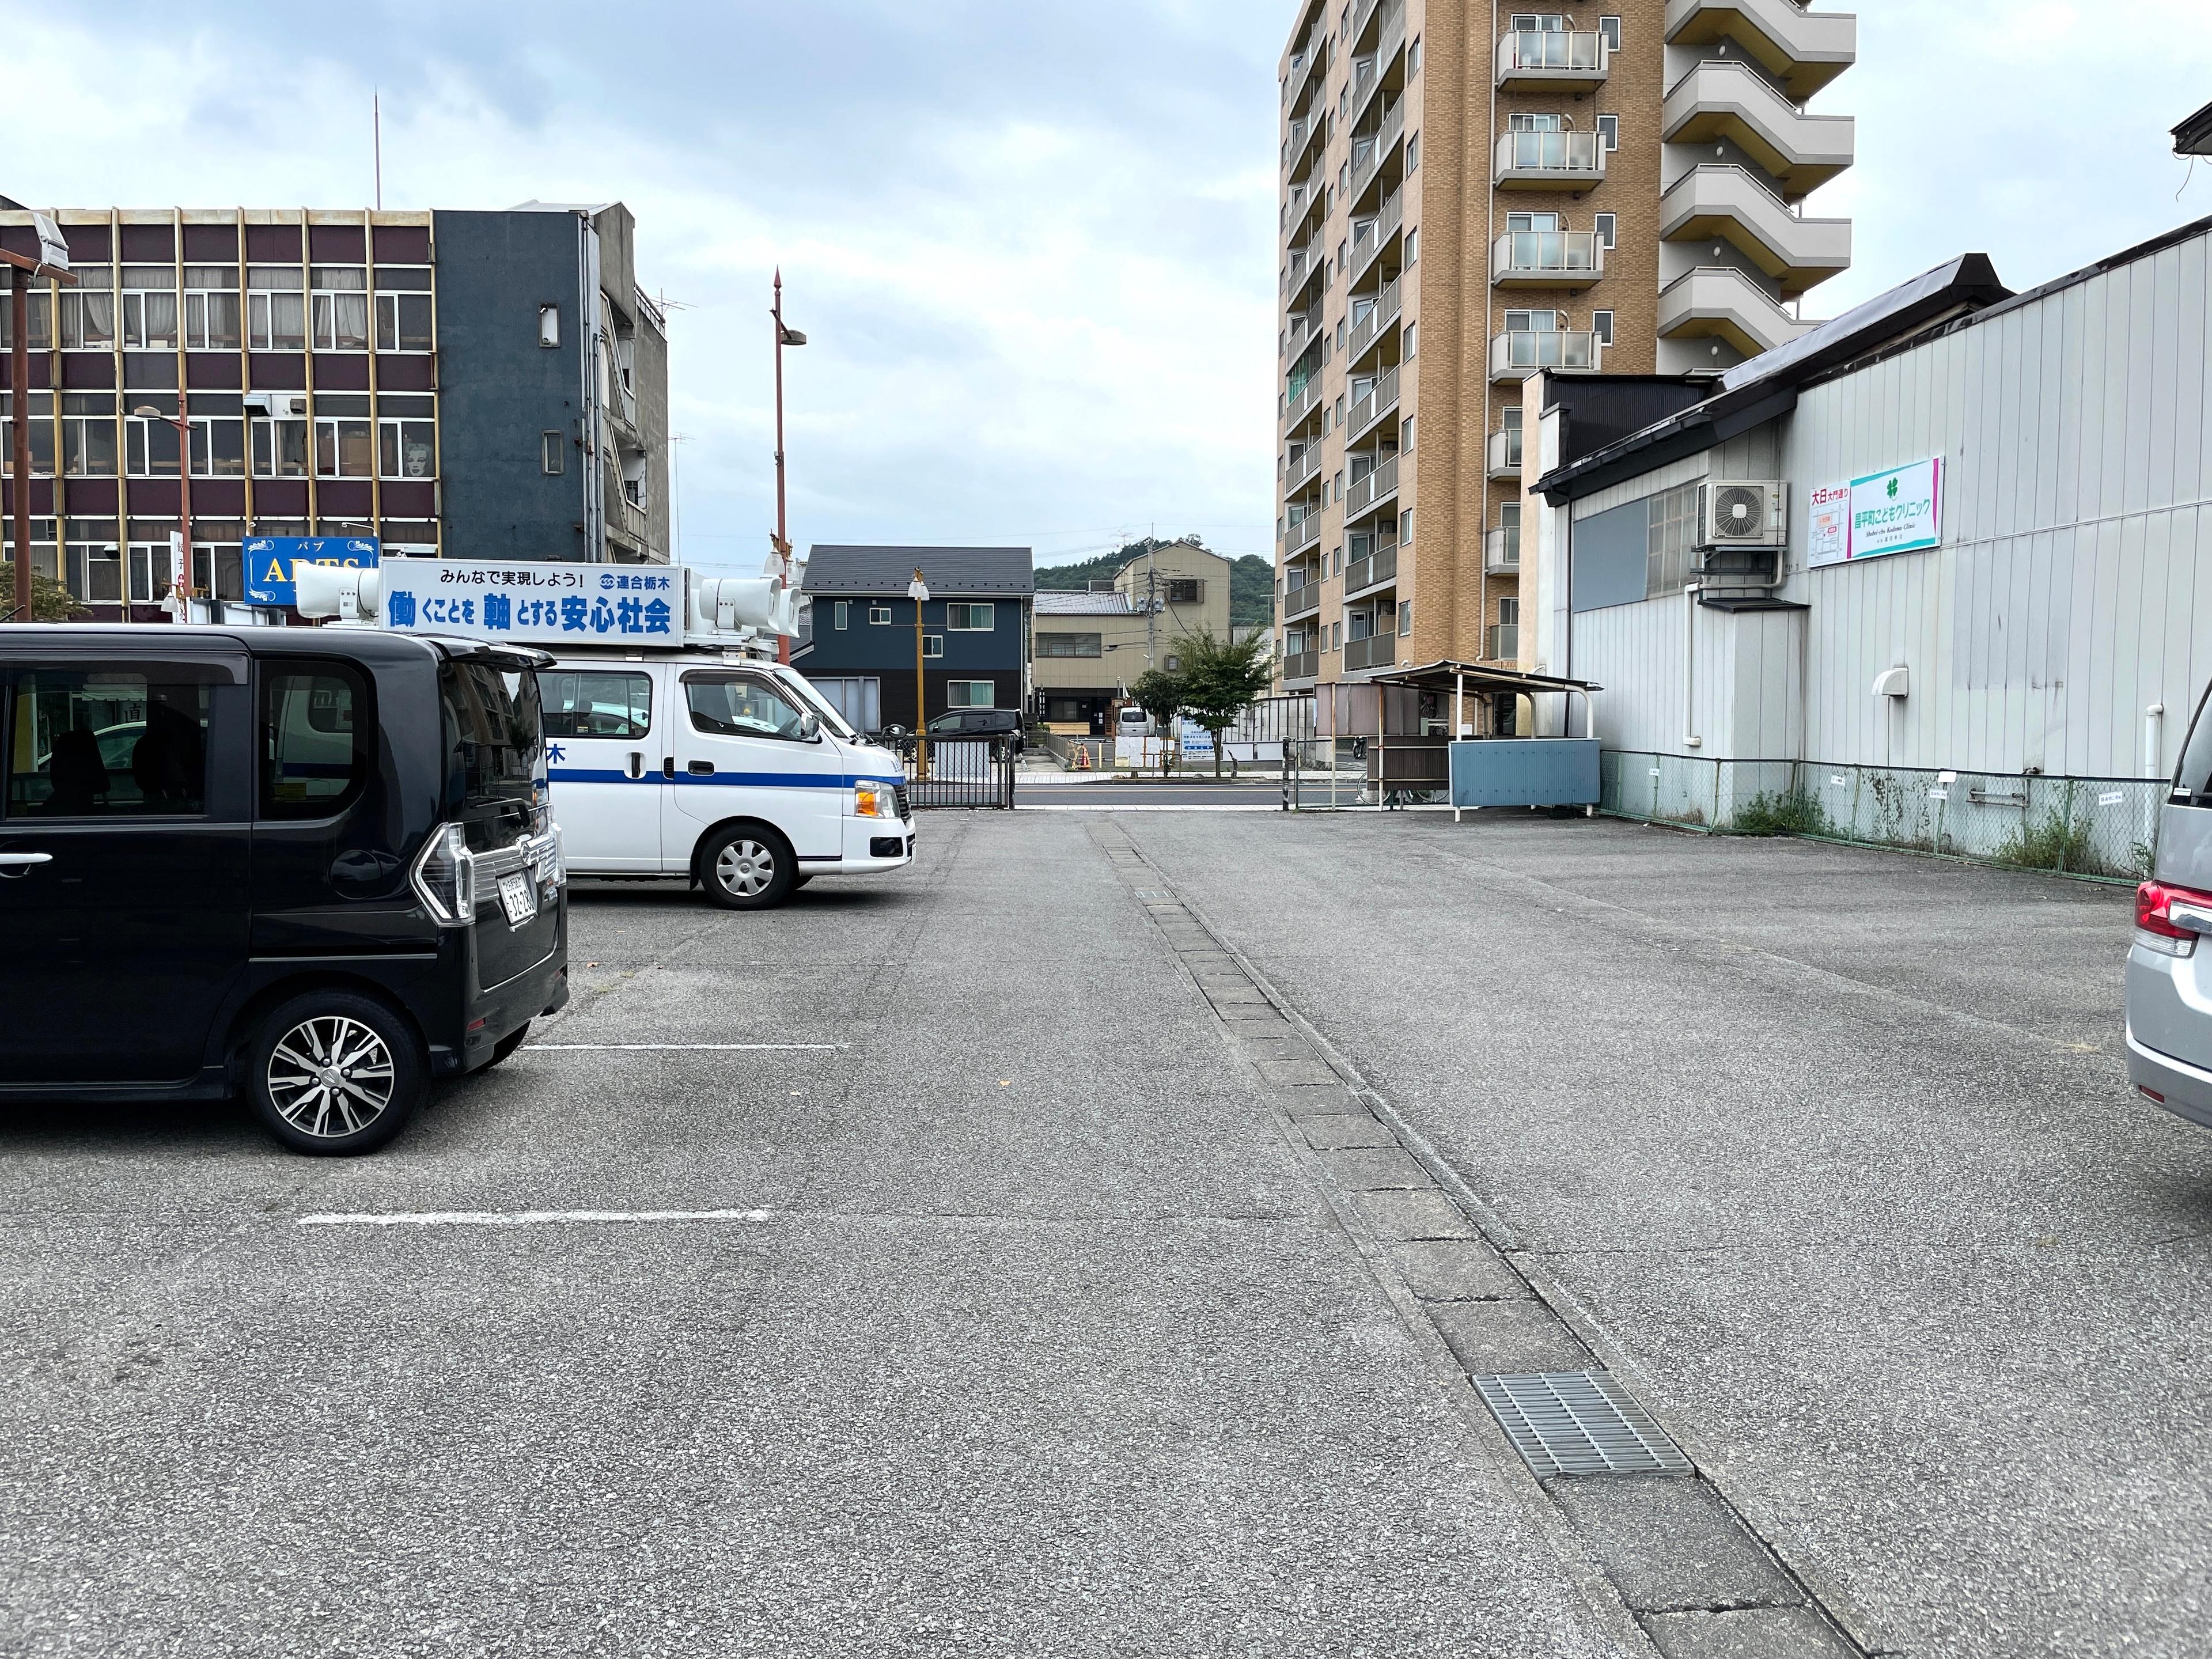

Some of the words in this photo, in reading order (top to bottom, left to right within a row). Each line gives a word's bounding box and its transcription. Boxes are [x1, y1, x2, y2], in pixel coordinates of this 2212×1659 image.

[1854, 498, 1930, 529] 昌平町こどもクリニック
[440, 569, 584, 588] みんなで実現しよう！
[616, 575, 671, 590] 連合栃木
